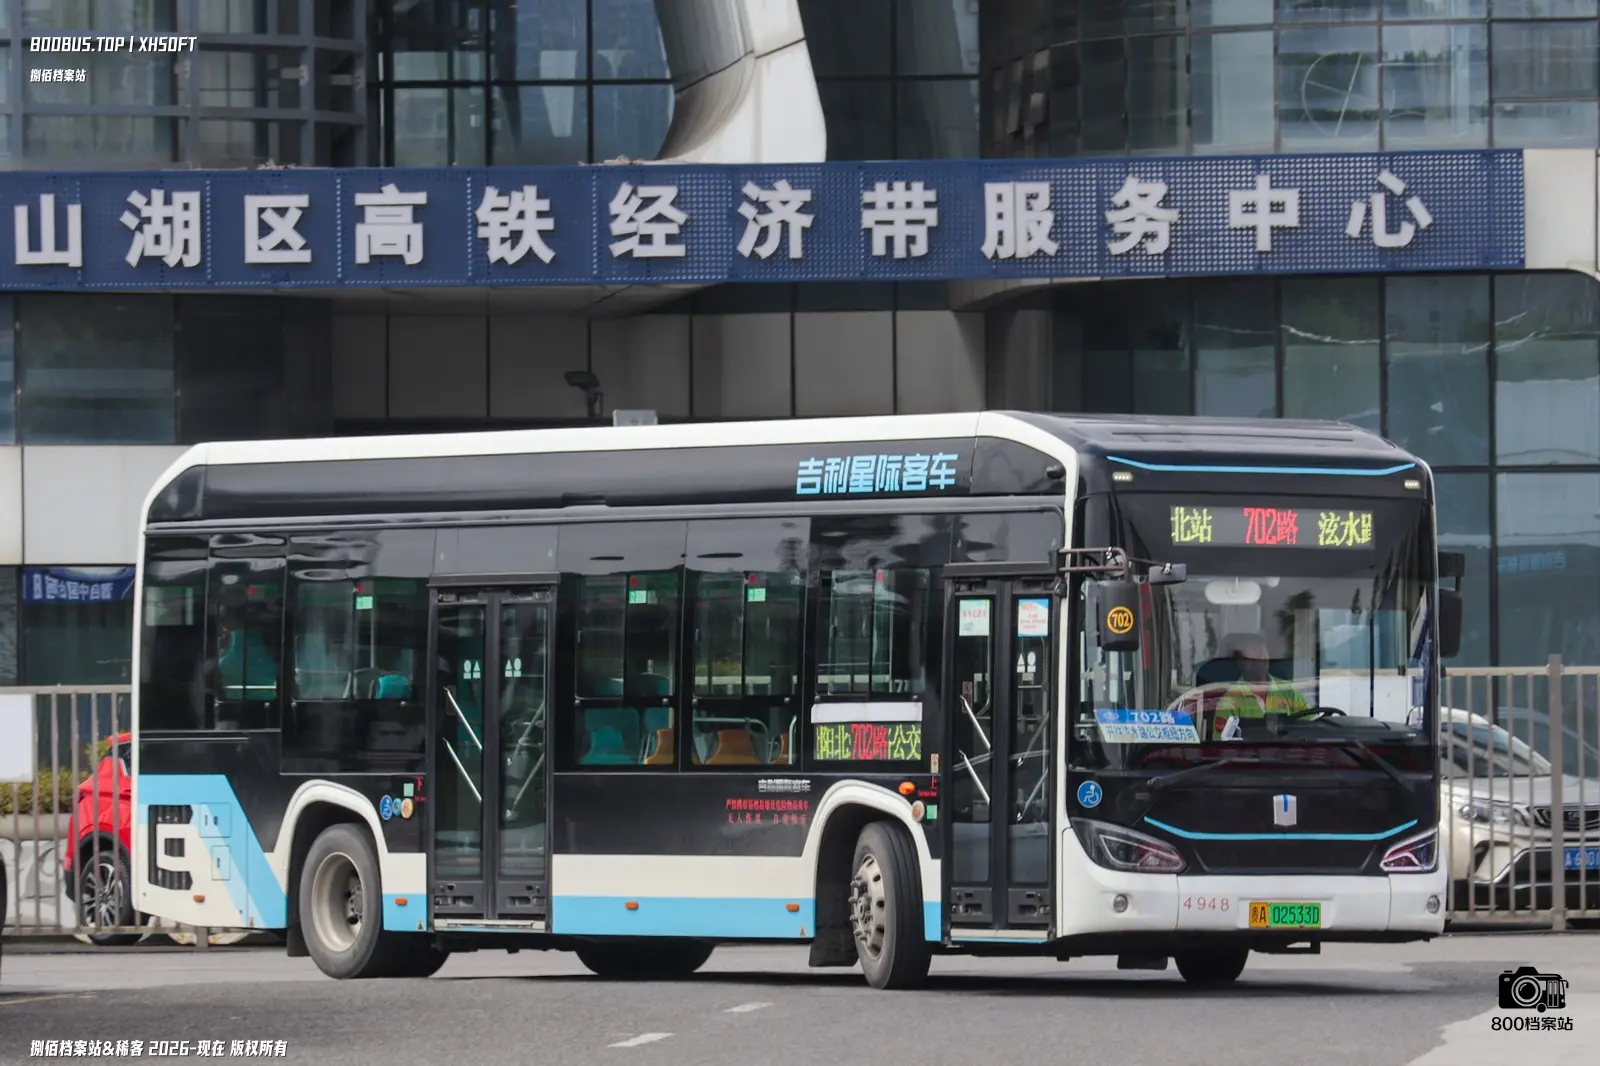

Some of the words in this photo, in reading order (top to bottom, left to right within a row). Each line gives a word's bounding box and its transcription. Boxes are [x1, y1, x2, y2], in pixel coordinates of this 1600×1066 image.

[13, 171, 1435, 270] 山湖区高铁经济带服务中心
[796, 452, 959, 495] 吉利星际客车
[1170, 506, 1213, 543] 北站
[1243, 507, 1299, 545] 702路
[1111, 612, 1130, 628] 702
[1183, 896, 1230, 912] 4948
